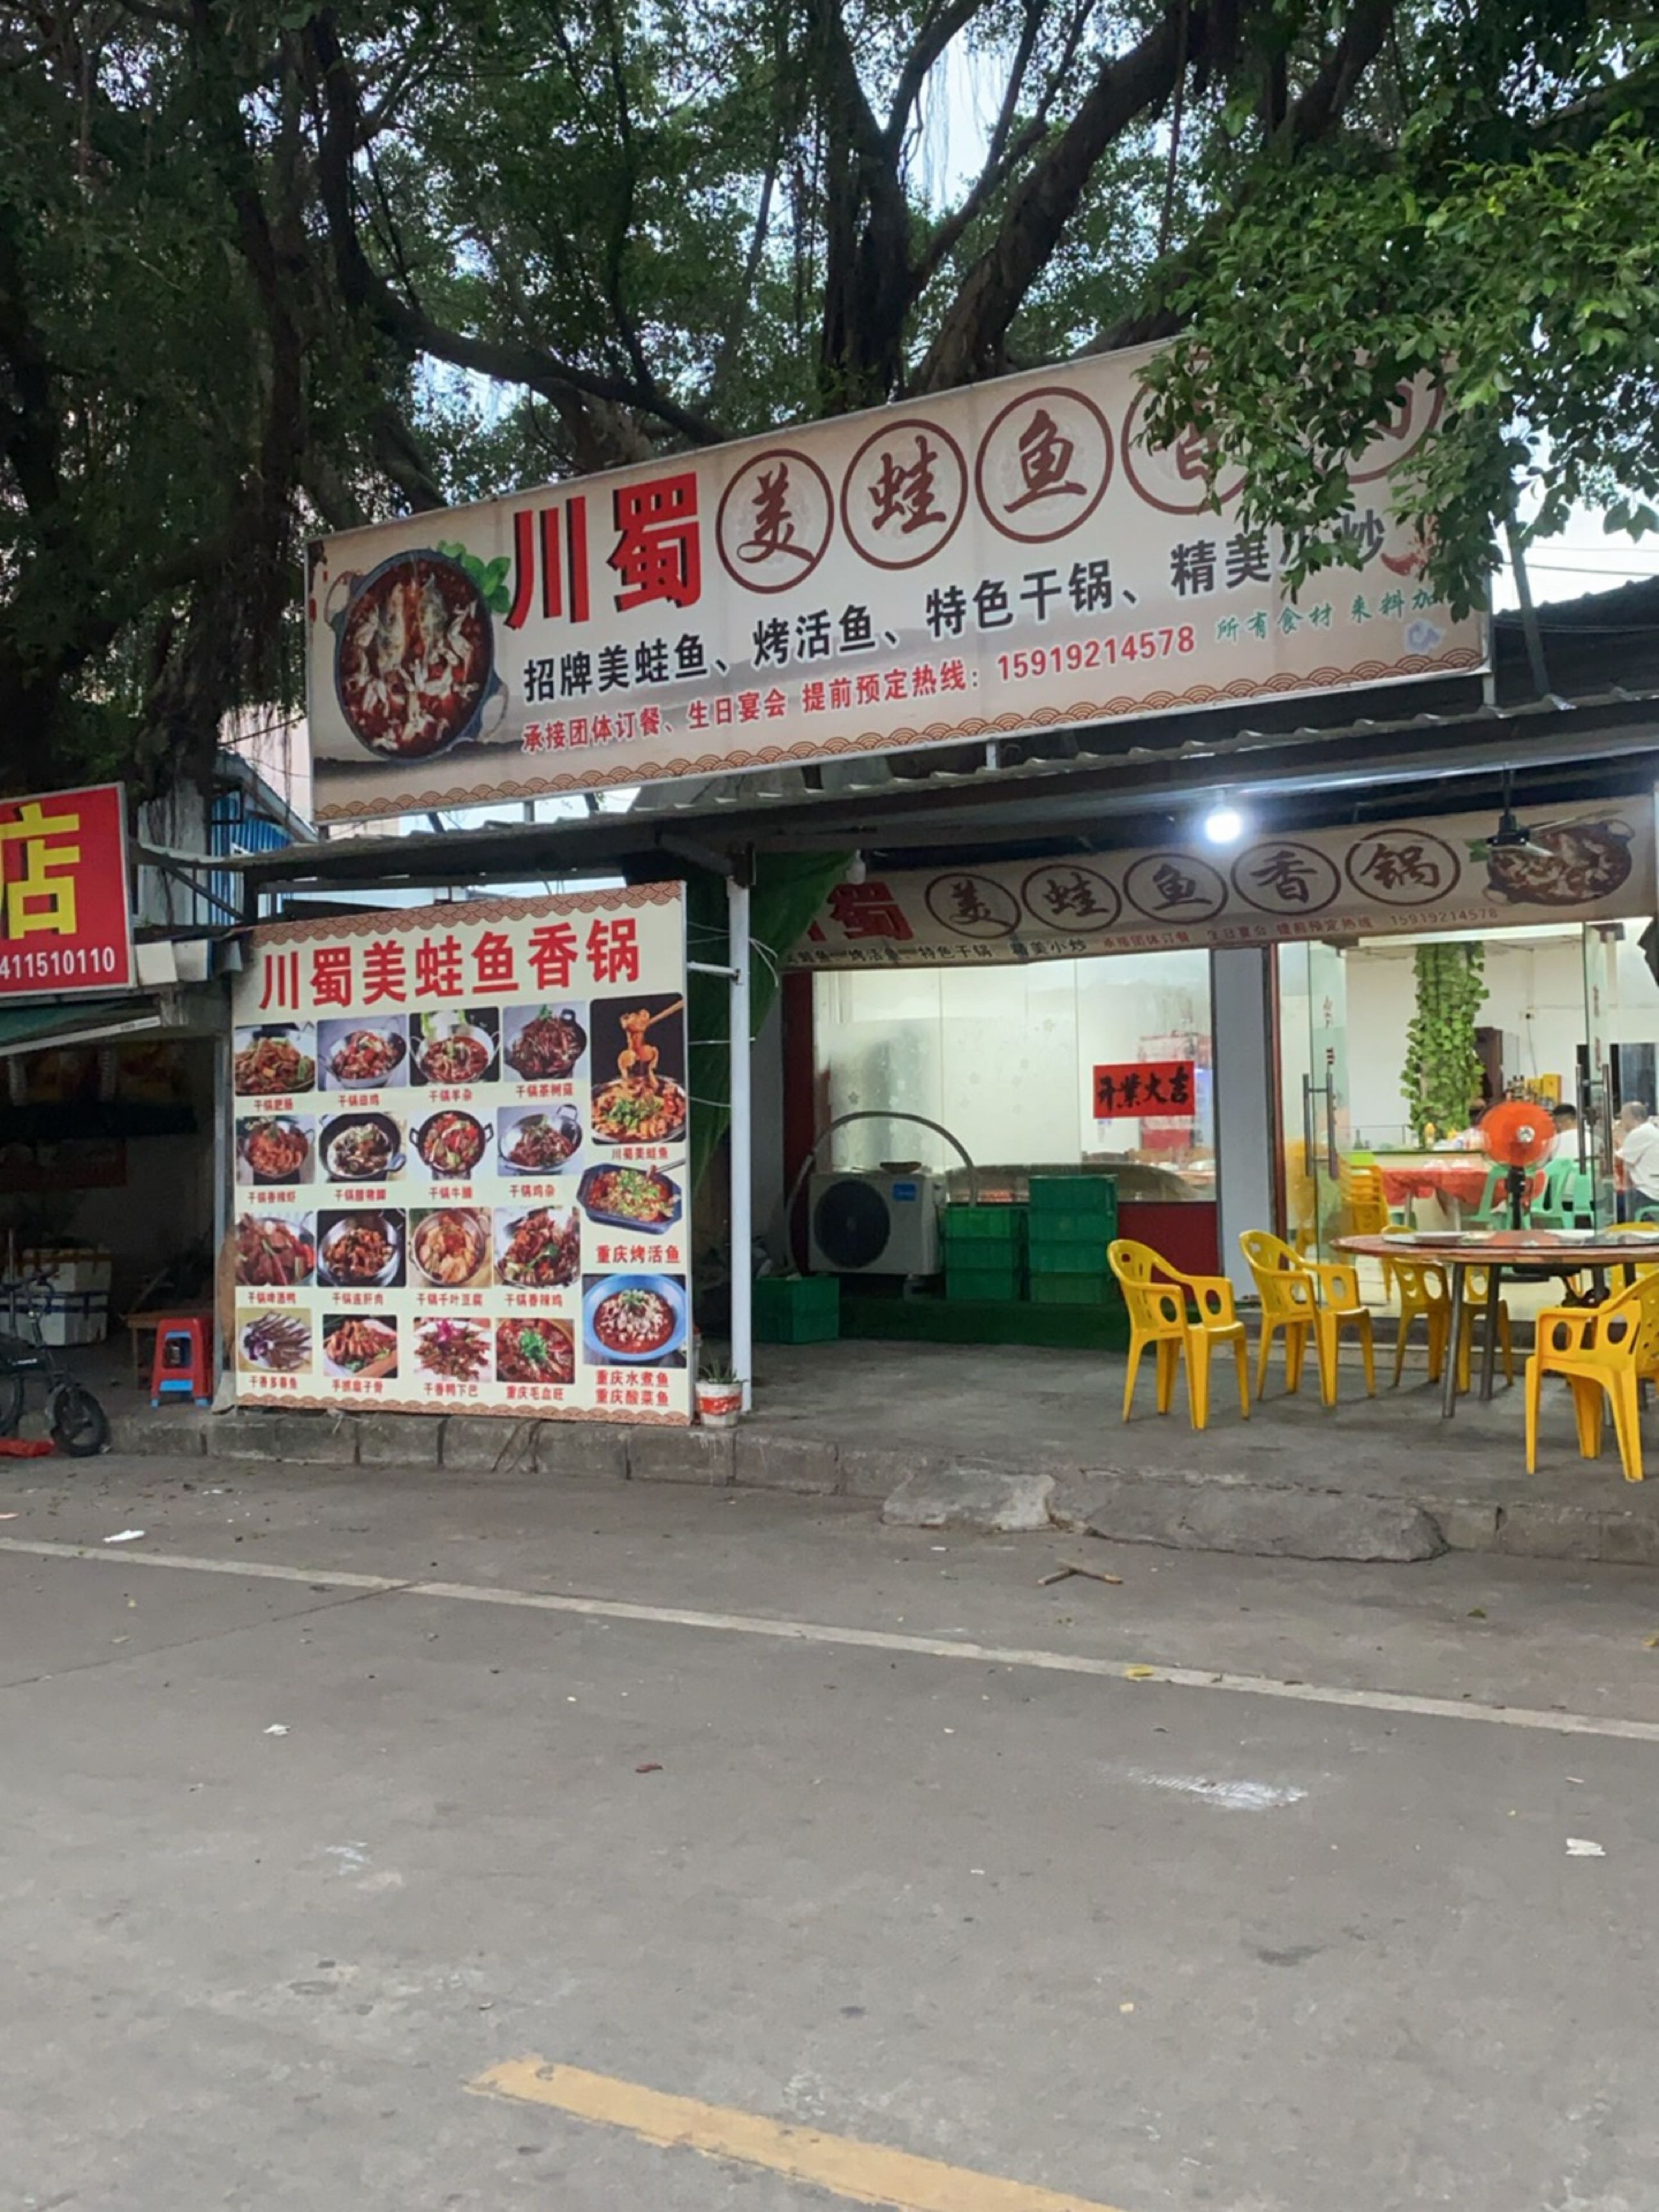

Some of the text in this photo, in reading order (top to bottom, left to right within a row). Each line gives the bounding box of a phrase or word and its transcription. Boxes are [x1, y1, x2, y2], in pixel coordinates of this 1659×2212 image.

[505, 472, 702, 630] 川蜀
[521, 687, 787, 753] 承接团体订餐、生日宴会
[998, 625, 1194, 680] 15919214578
[0, 802, 81, 940] 店
[808, 881, 914, 942] 蜀
[0, 945, 116, 981] 411510110
[259, 917, 640, 1011] 川蜀美蛙鱼香锅
[611, 1147, 669, 1160] 川蜀美蛙鱼
[596, 1244, 681, 1264] 重庆烤活鱼
[596, 1369, 669, 1388] 重庆水煮鱼
[596, 1387, 669, 1407] 重庆酸菜鱼
